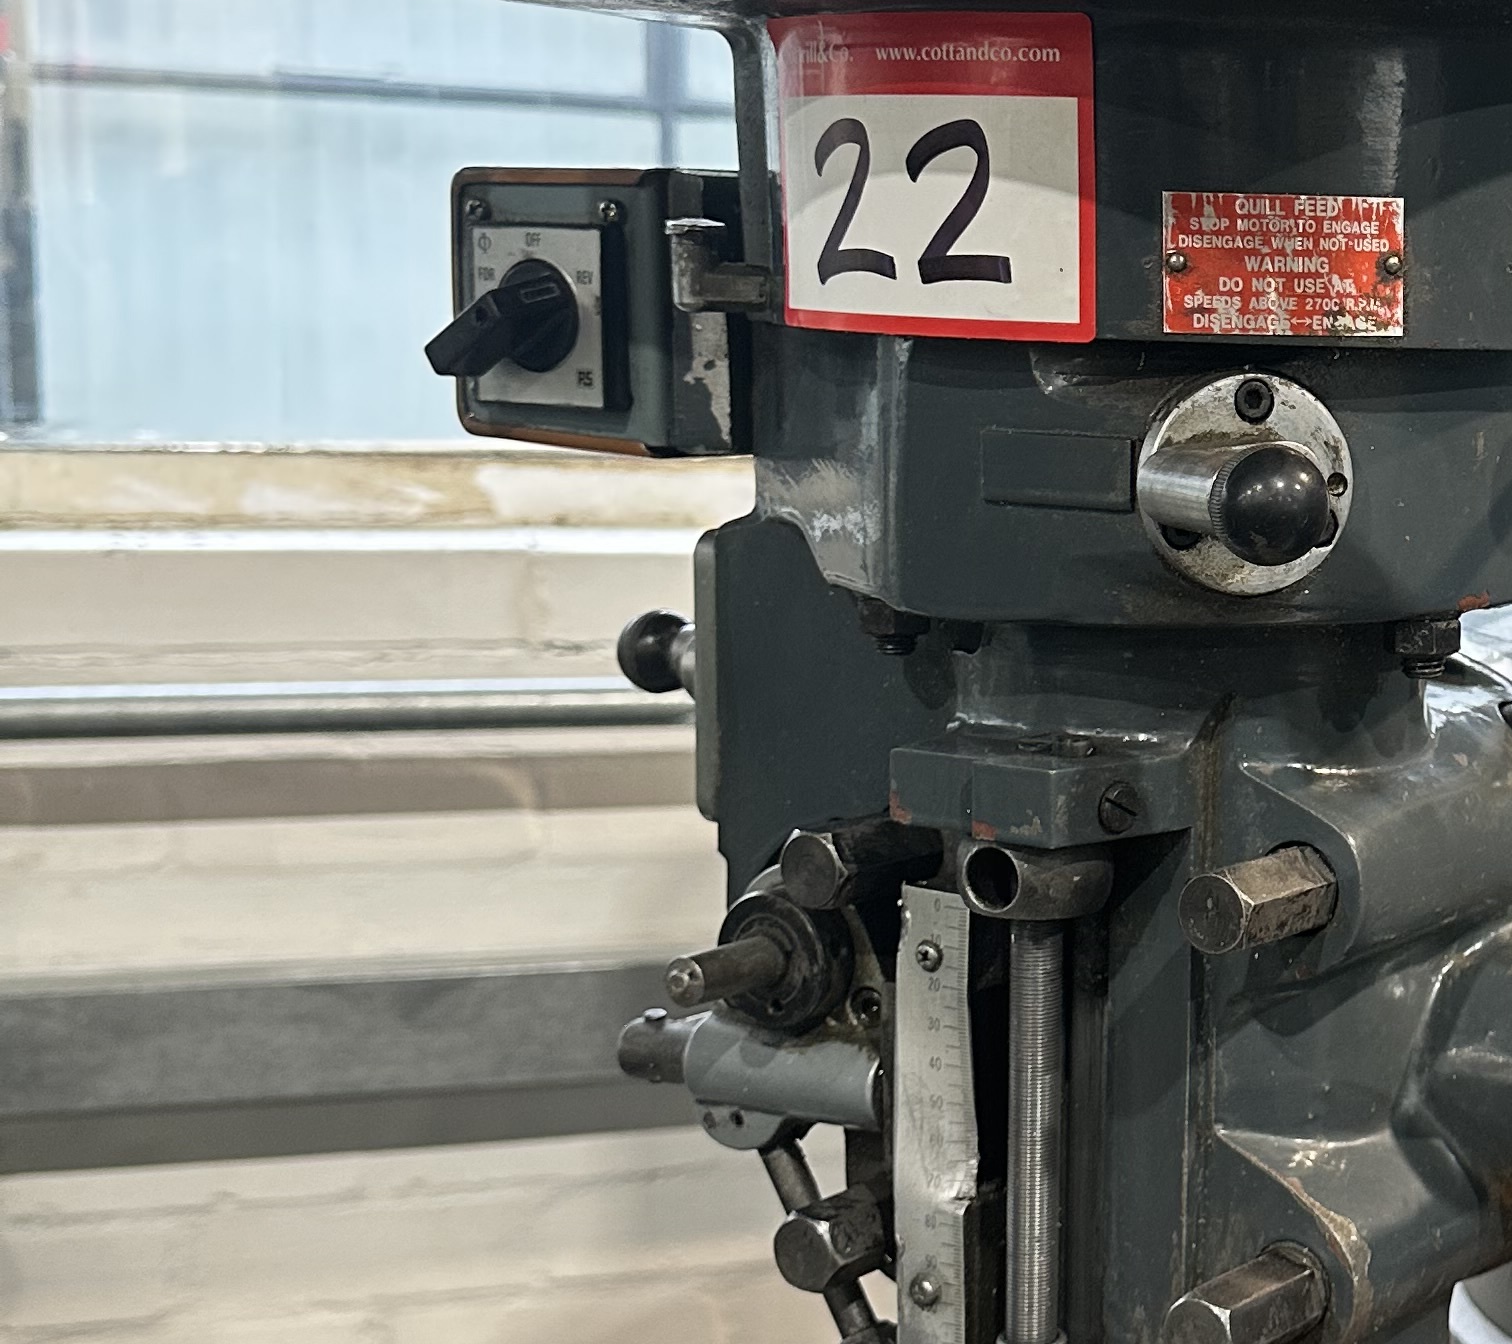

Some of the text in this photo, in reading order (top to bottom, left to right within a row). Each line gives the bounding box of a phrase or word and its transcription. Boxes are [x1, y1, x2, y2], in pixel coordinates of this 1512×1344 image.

[876, 41, 1061, 63] www.cottandco.com
[814, 118, 1012, 285] 22
[1235, 198, 1339, 217] QUILL FEED
[1189, 217, 1379, 235] SOP MOTOR TO ENGAGE
[525, 232, 541, 247] OFF
[1178, 234, 1390, 253] DISENGAGE WHEN NOT USED
[1244, 255, 1329, 273] WARNING
[576, 270, 593, 285] REV
[1219, 276, 1356, 295] DO NOT USE AT
[1183, 294, 1242, 309] SPEEDS
[1249, 296, 1298, 311] ABOVE
[1193, 313, 1291, 331] DISENGAGE
[934, 898, 941, 913] 0
[928, 977, 940, 992] 20
[927, 1017, 940, 1032] 30
[929, 1056, 942, 1072] 40
